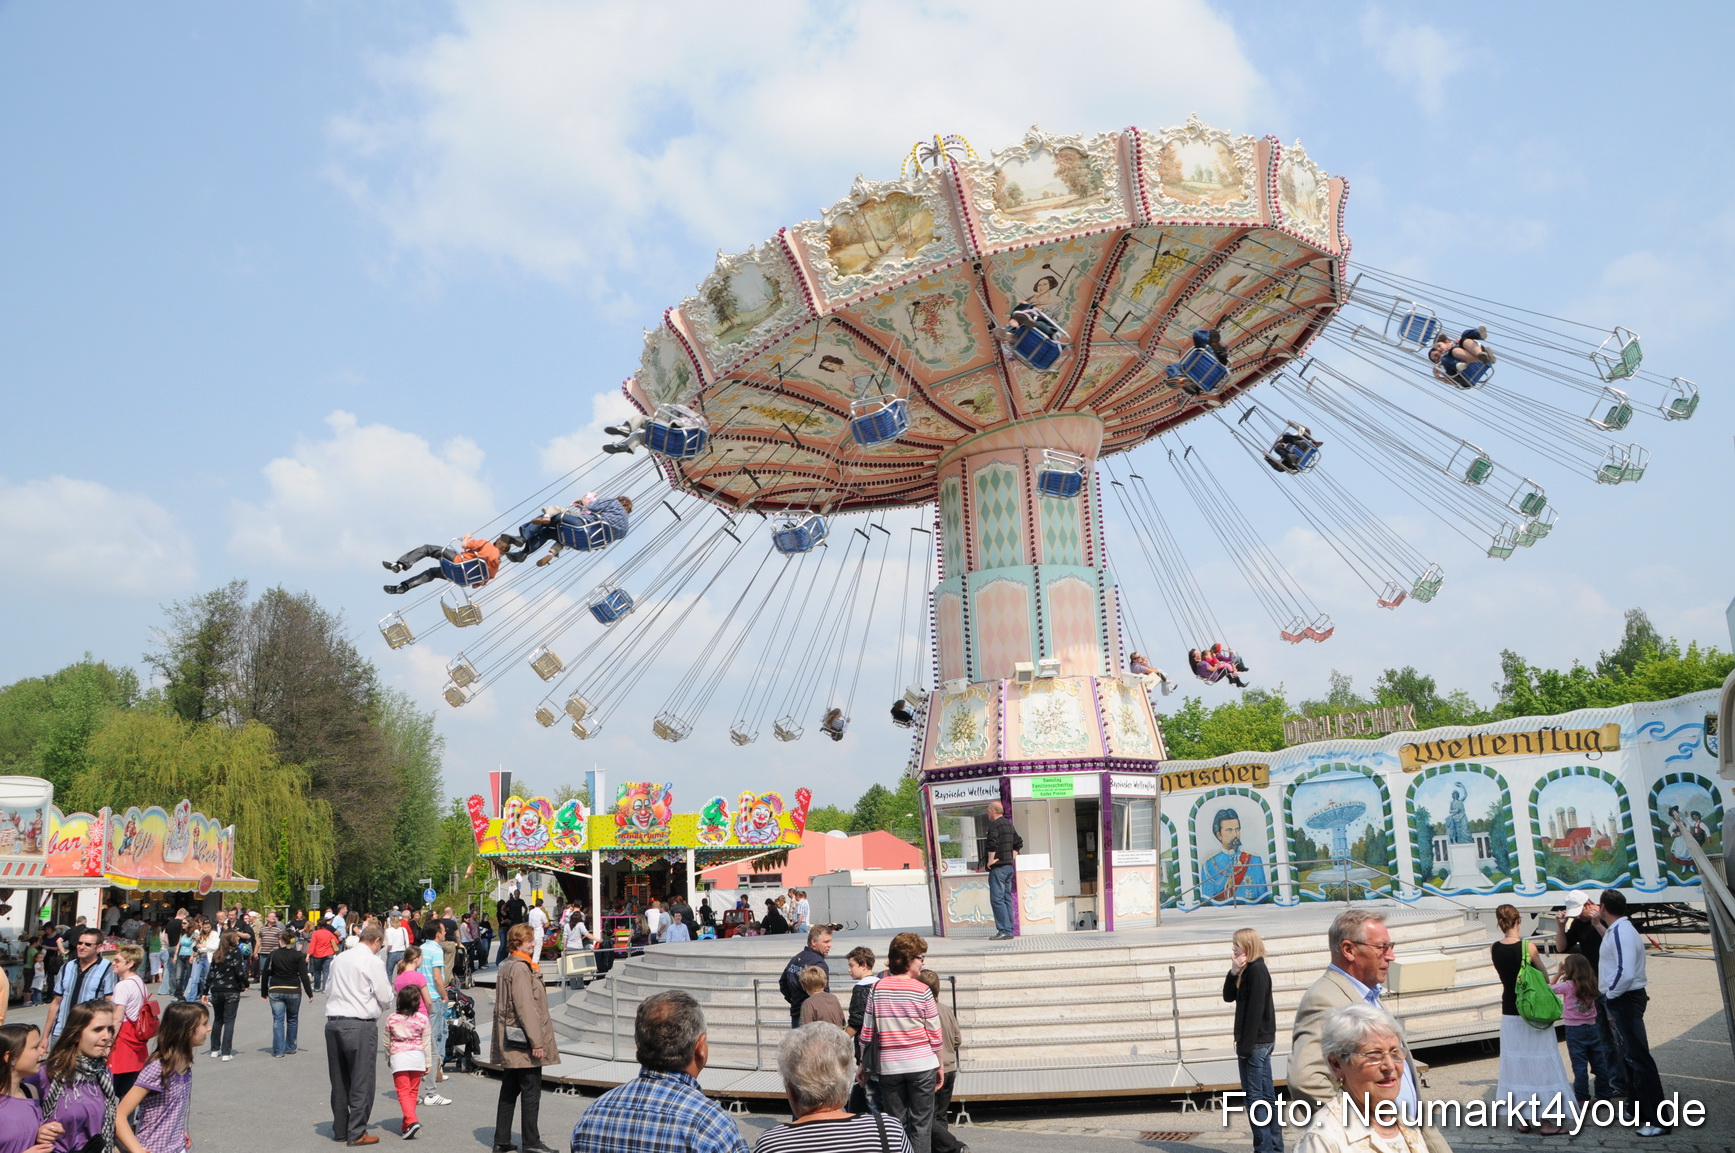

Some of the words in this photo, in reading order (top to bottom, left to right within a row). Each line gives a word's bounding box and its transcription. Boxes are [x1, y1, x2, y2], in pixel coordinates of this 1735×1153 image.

[1283, 703, 1417, 745] DRELISCHEK
[1160, 761, 1263, 798] yrischer
[1401, 725, 1603, 764] Wellenflug
[934, 788, 966, 801] Bayrischer
[967, 784, 1001, 797] Wellenflu
[48, 830, 82, 856] bar
